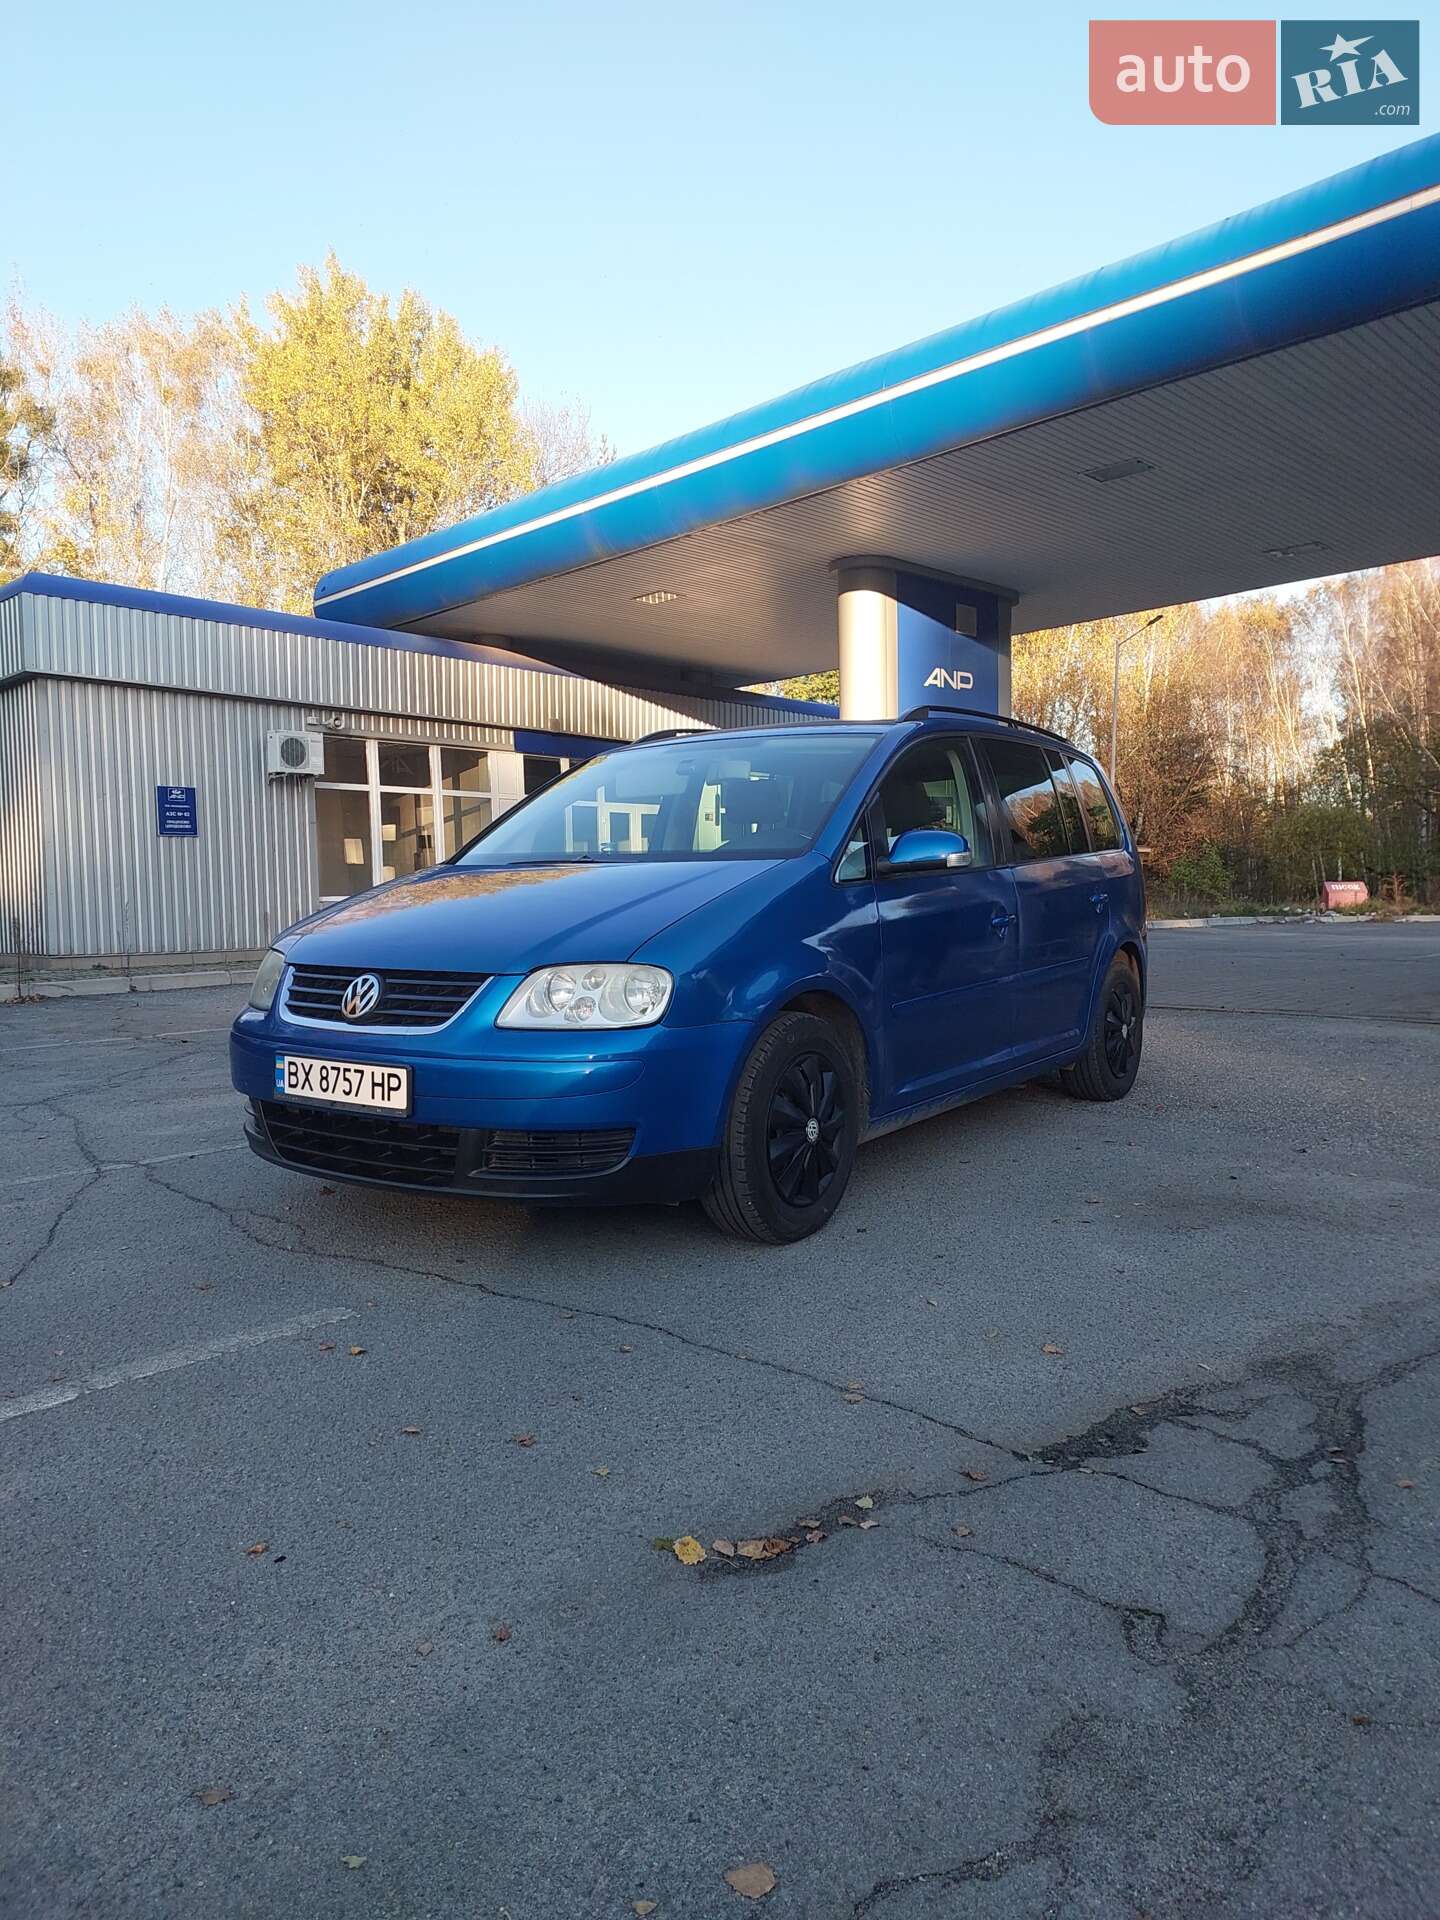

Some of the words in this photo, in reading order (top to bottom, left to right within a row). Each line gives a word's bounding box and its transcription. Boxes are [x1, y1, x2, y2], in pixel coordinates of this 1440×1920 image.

[276, 1080, 284, 1088] UA
[288, 1062, 313, 1091] BX
[319, 1065, 364, 1097] 8757
[371, 1072, 401, 1101] HP
